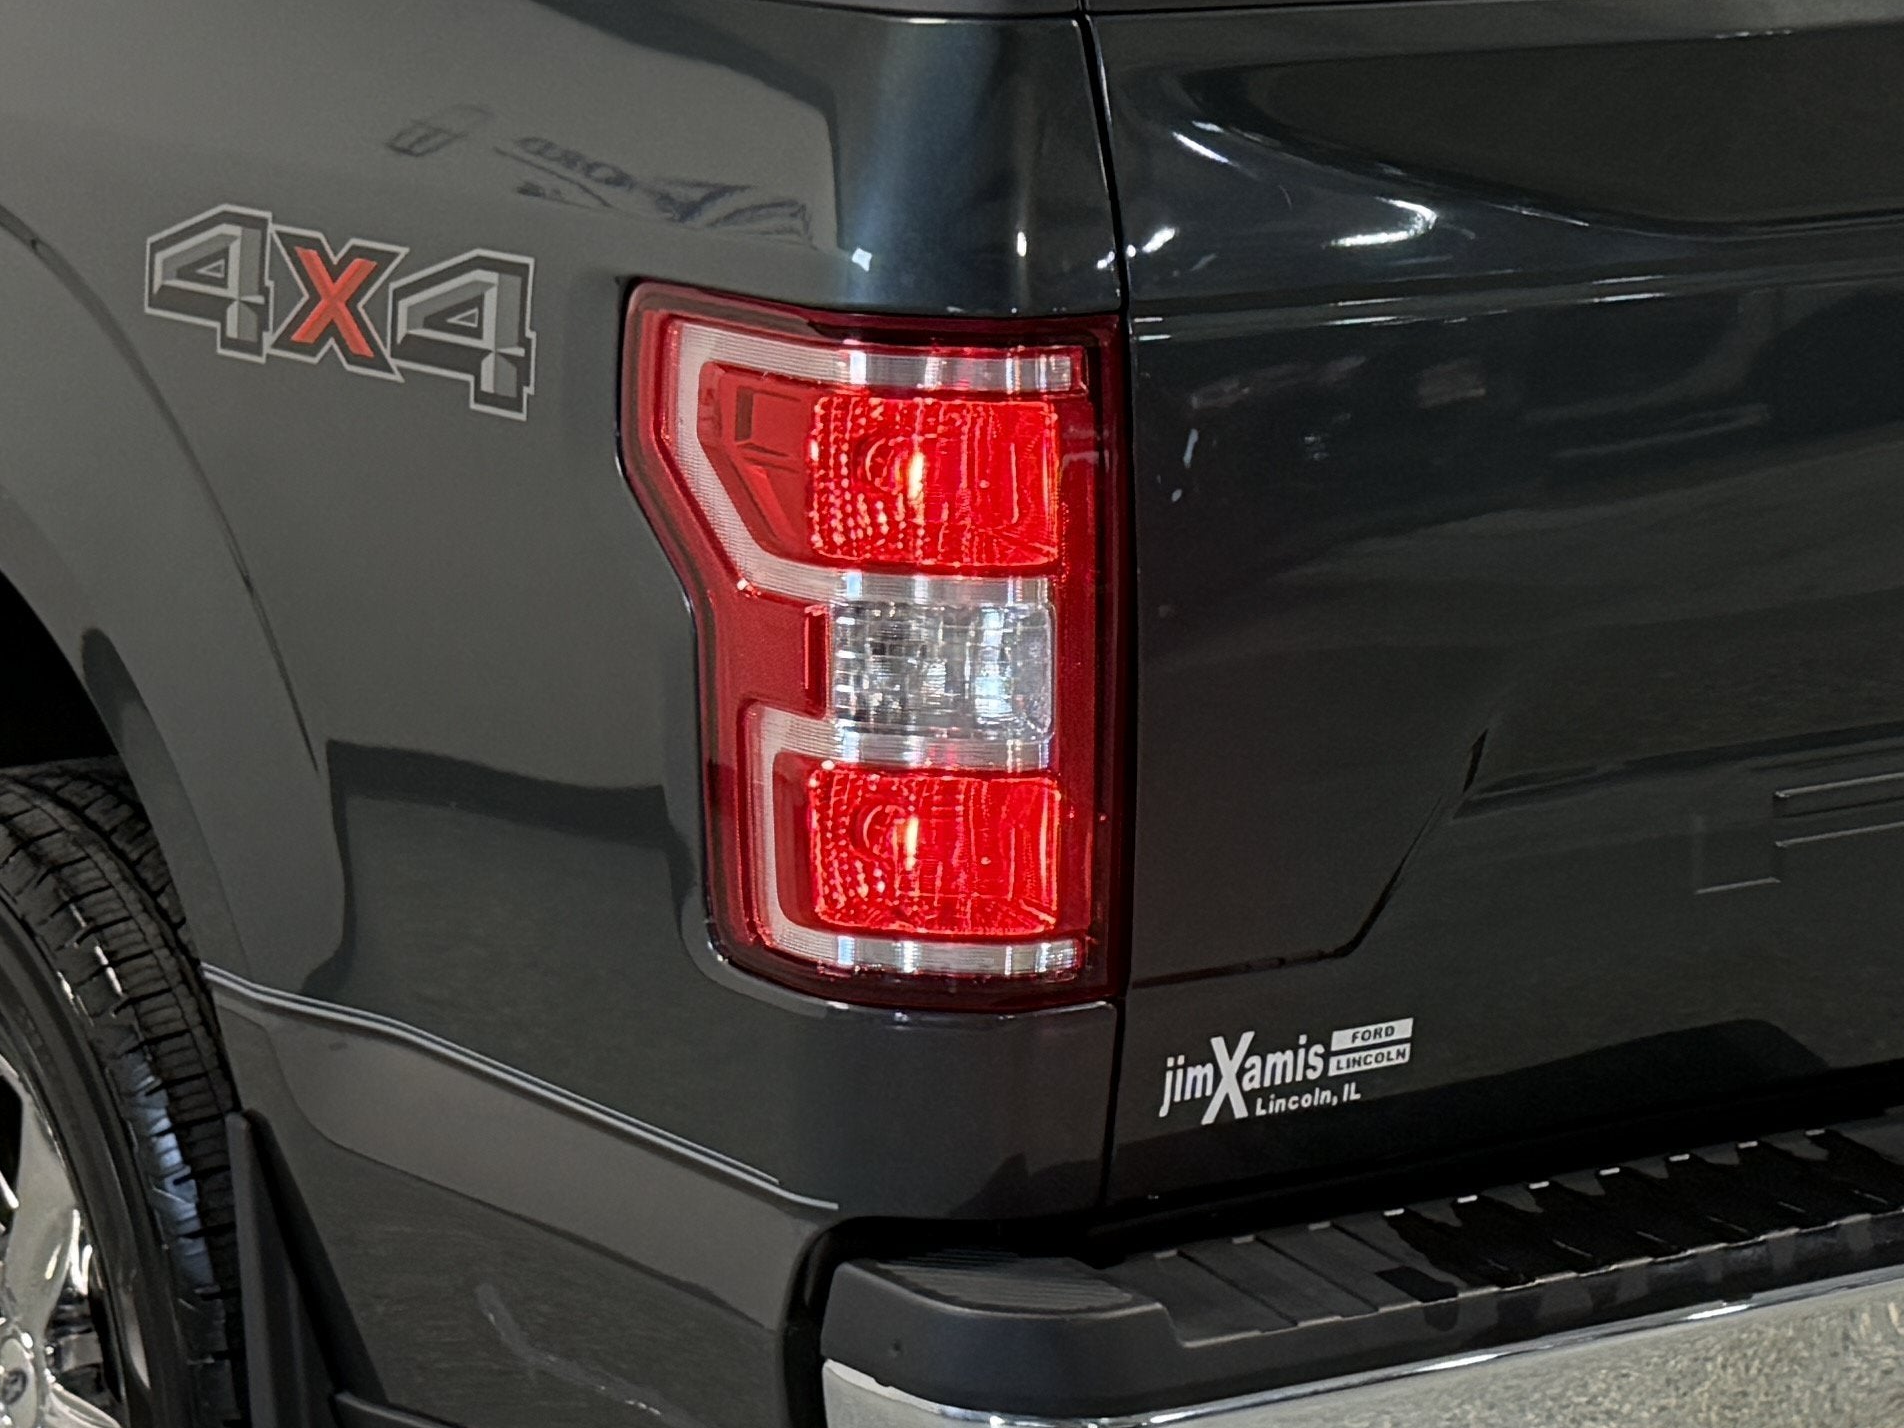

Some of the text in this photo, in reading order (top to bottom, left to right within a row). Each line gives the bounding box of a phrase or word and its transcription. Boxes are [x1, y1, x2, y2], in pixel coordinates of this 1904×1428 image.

[1350, 1024, 1396, 1045] FORD
[1335, 1047, 1408, 1072] LINCOLN
[1254, 1081, 1362, 1117] Lincoln, IL
